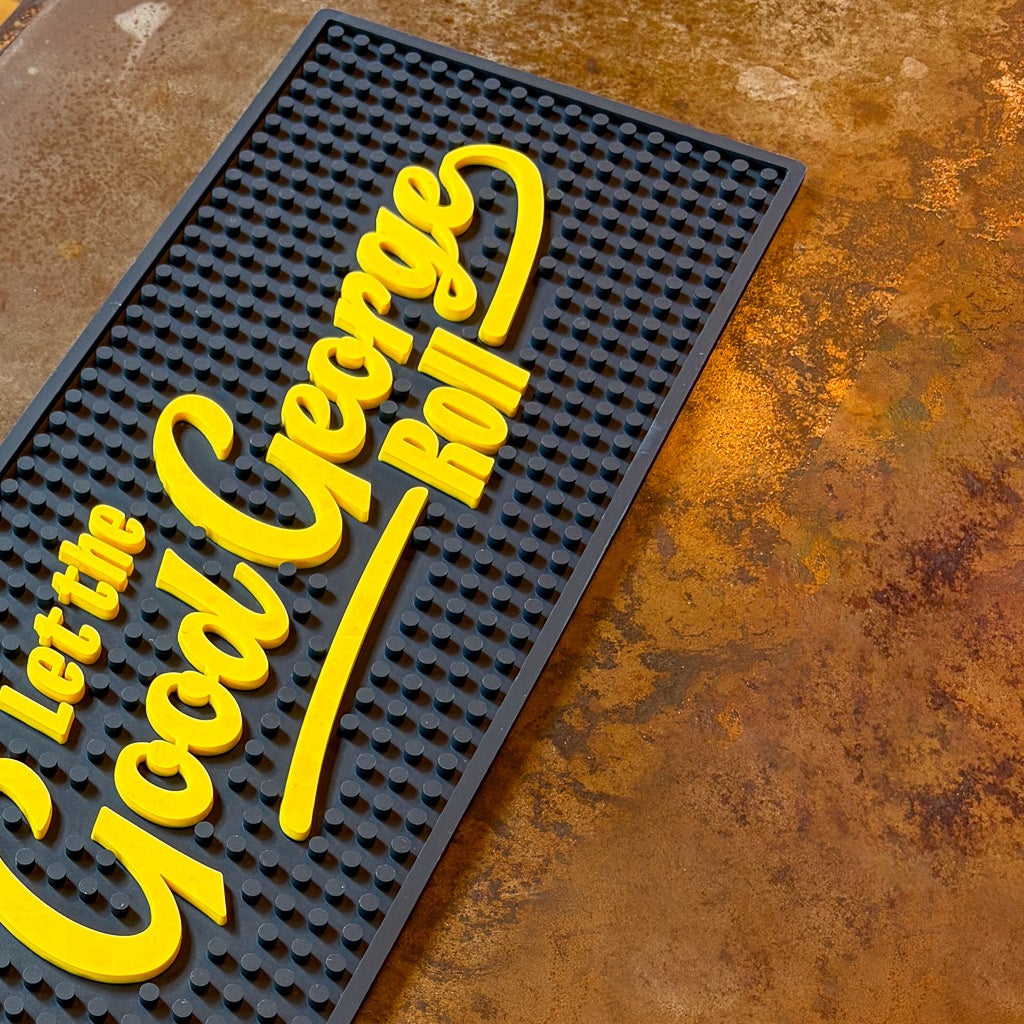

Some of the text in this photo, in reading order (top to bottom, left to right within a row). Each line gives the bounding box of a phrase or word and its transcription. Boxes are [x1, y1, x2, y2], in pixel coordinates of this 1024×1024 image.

[152, 143, 545, 569] George
[378, 326, 531, 509] Roll
[51, 503, 147, 621] the
